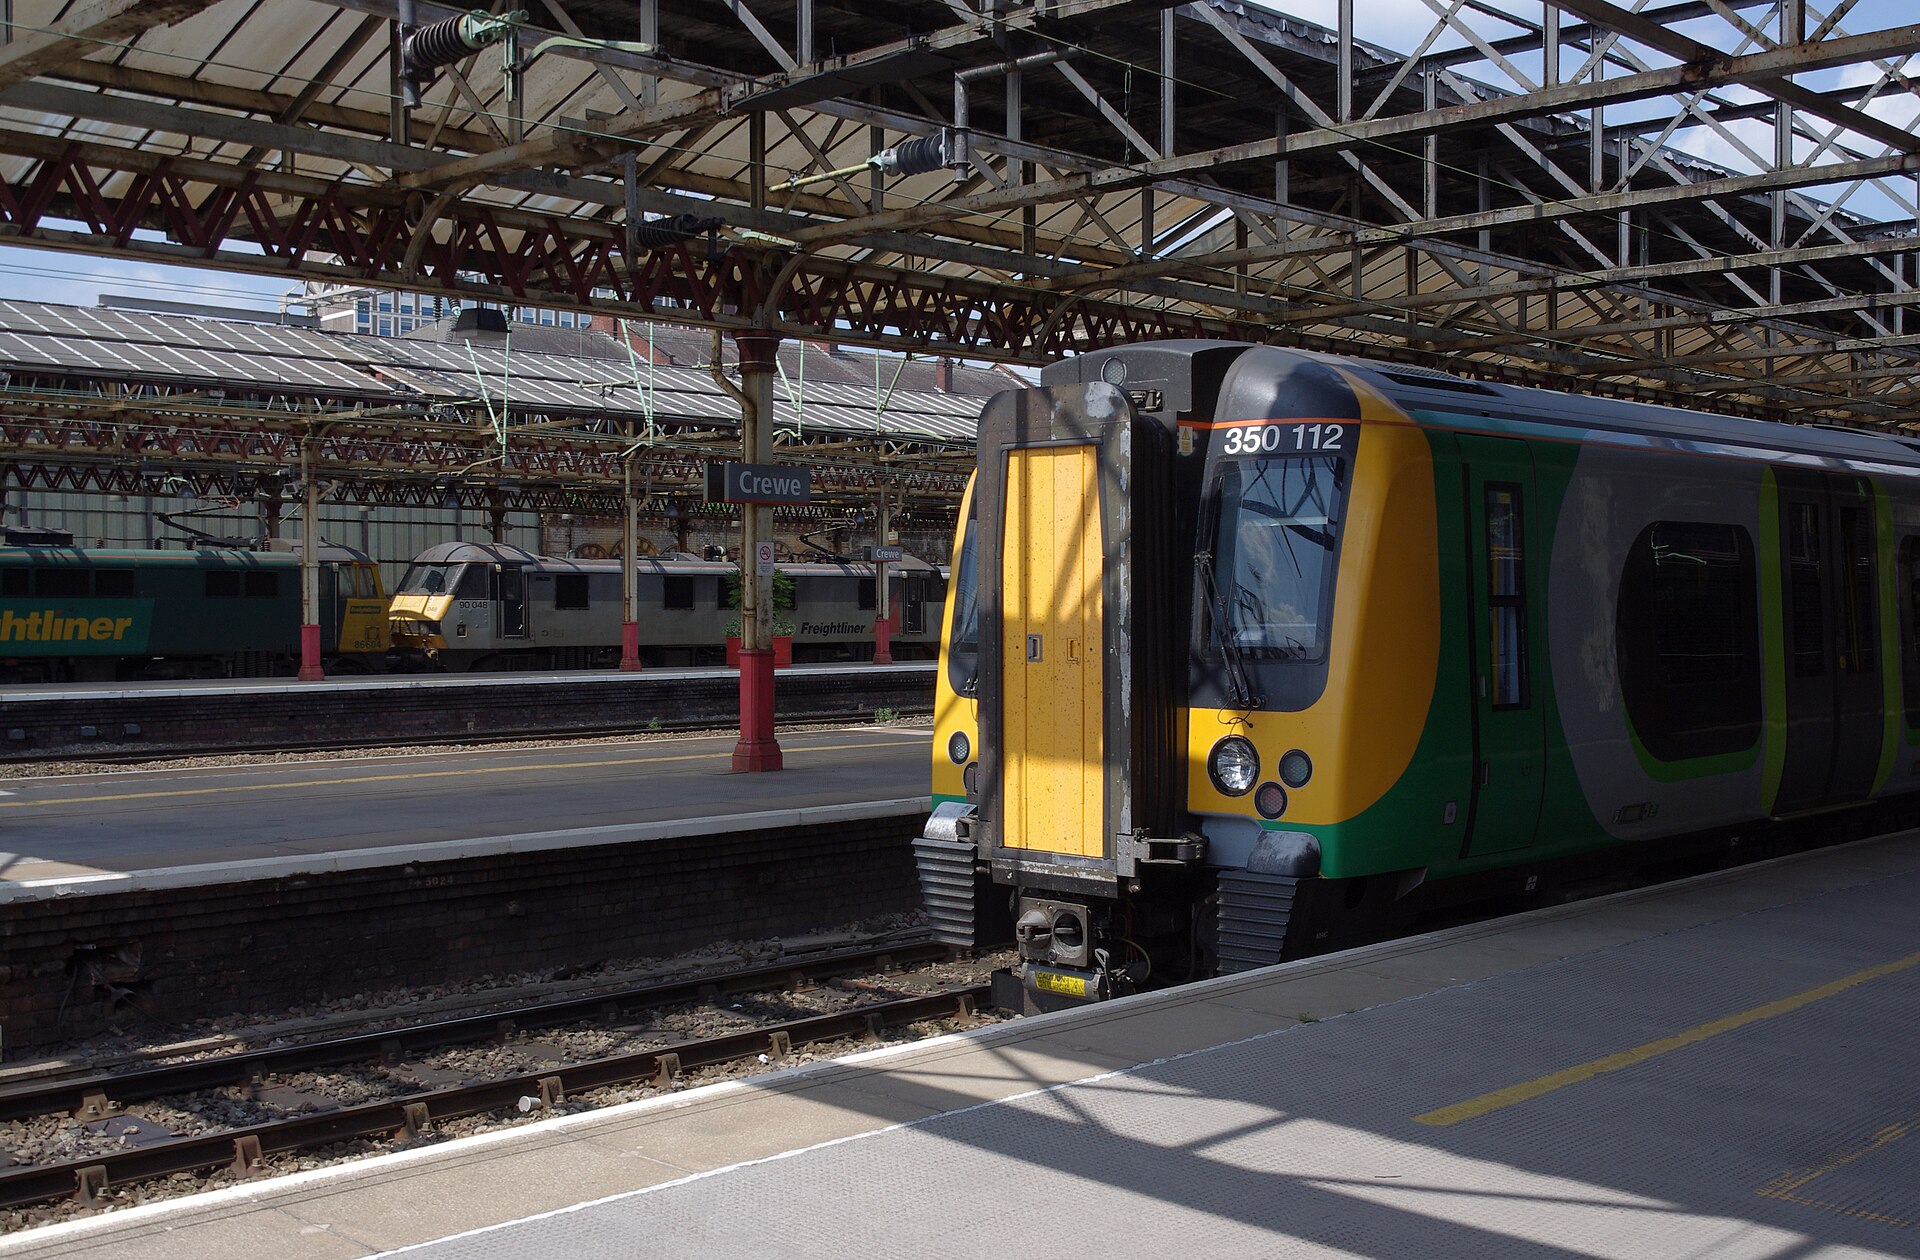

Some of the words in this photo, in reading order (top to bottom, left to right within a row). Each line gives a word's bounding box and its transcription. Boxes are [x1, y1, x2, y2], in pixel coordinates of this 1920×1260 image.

[1223, 424, 1281, 455] 350
[1292, 423, 1344, 451] 112
[739, 470, 801, 496] Crewe
[876, 548, 899, 559] Crewe
[459, 601, 470, 609] 90
[472, 601, 488, 609] 048
[0, 609, 132, 641] htliner
[801, 622, 866, 637] Freightliner
